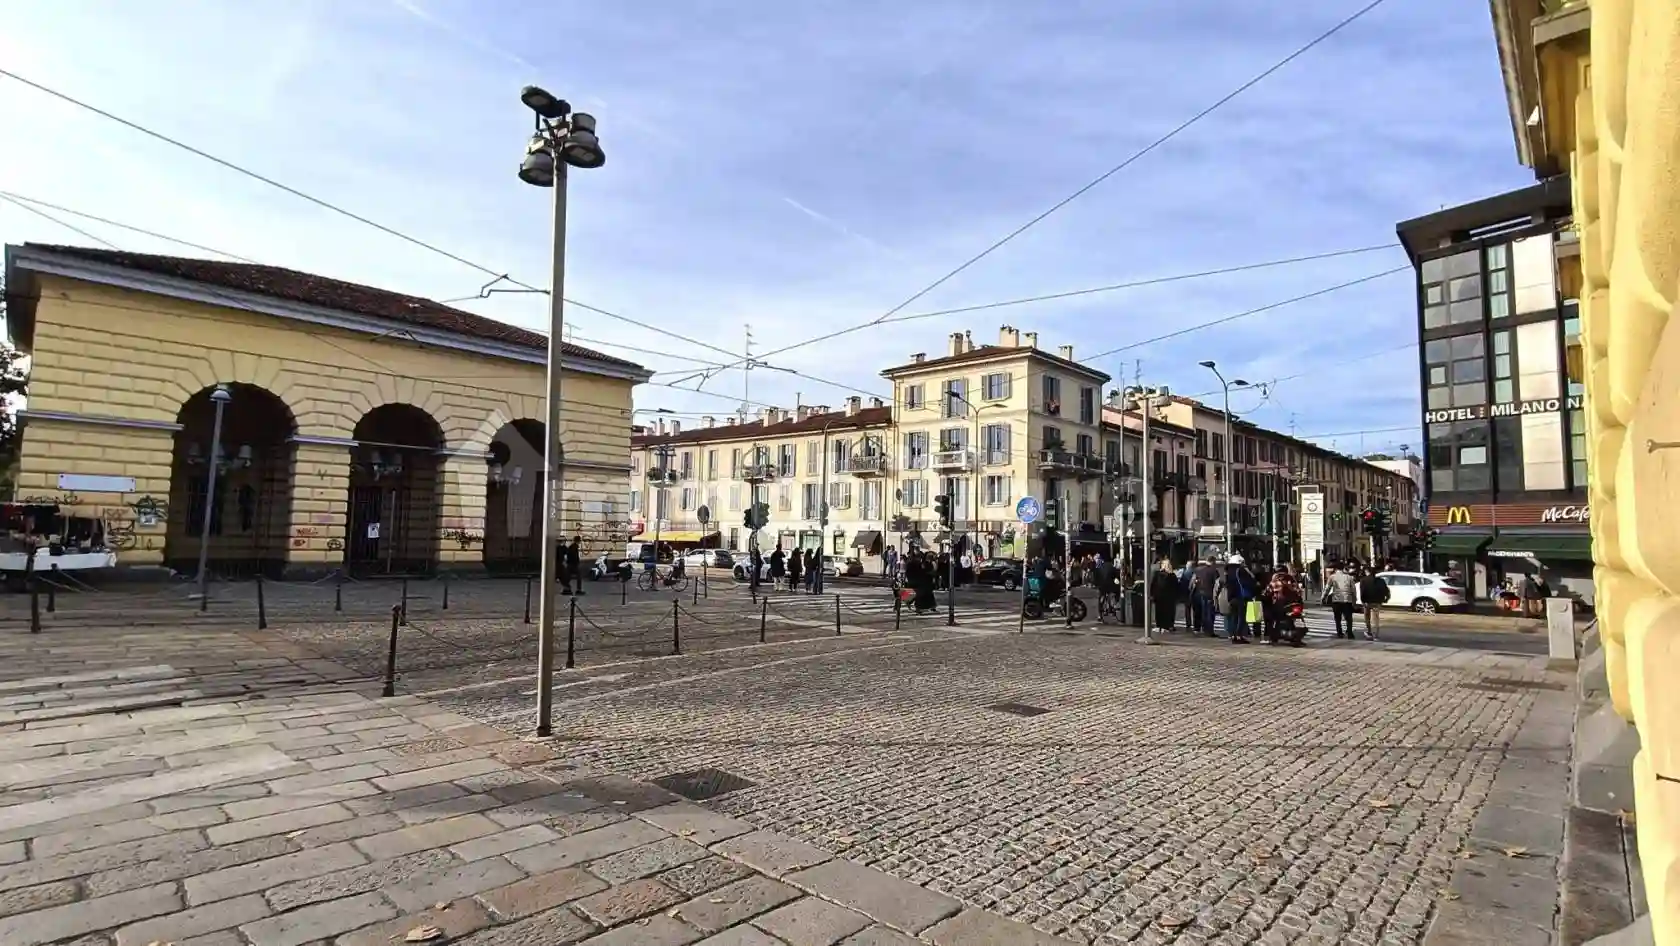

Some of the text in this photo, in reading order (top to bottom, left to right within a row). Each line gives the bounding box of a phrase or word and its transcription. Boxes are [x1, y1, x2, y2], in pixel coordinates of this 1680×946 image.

[1425, 396, 1585, 423] HOTEL MILANO N
